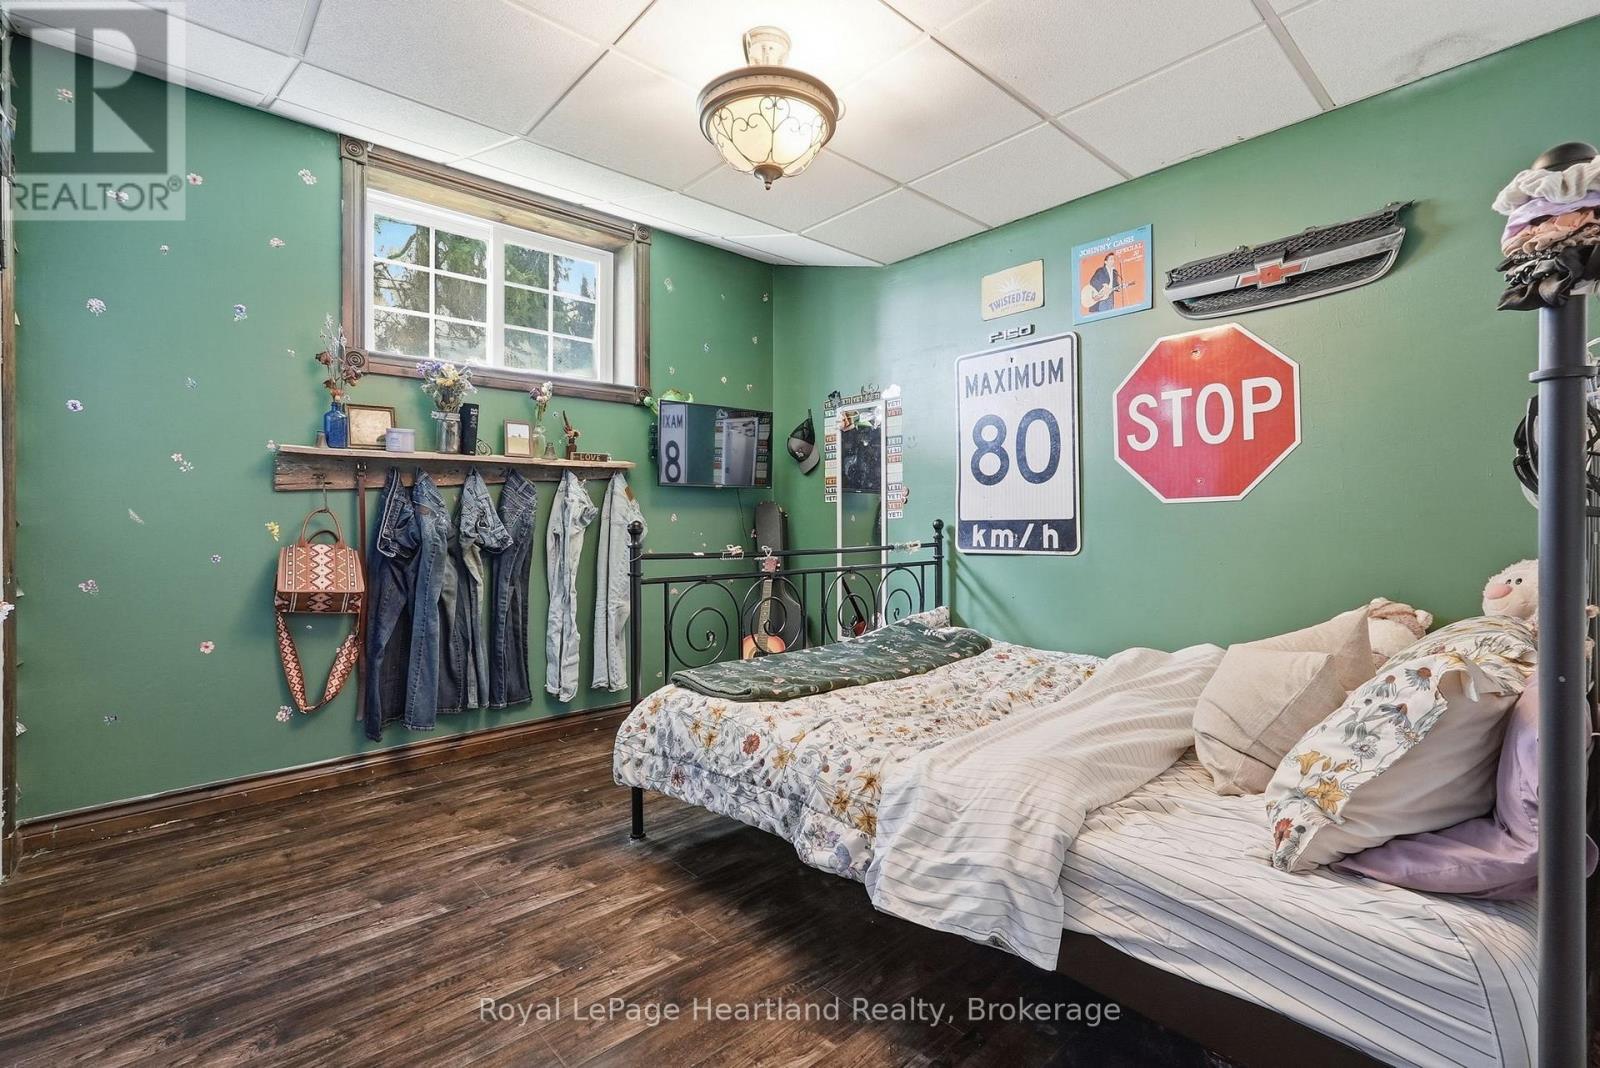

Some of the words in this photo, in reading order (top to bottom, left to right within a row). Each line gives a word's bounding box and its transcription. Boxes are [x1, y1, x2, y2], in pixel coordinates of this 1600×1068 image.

[1080, 243, 1113, 257] JOHNNY
[1113, 236, 1135, 248] CASH
[988, 292, 1021, 312] TWISTED
[1022, 290, 1037, 303] TEA
[965, 357, 1064, 398] MAXIMUM
[1126, 376, 1283, 452] STOP
[970, 408, 1061, 486] 80
[971, 522, 1060, 549] km/h
